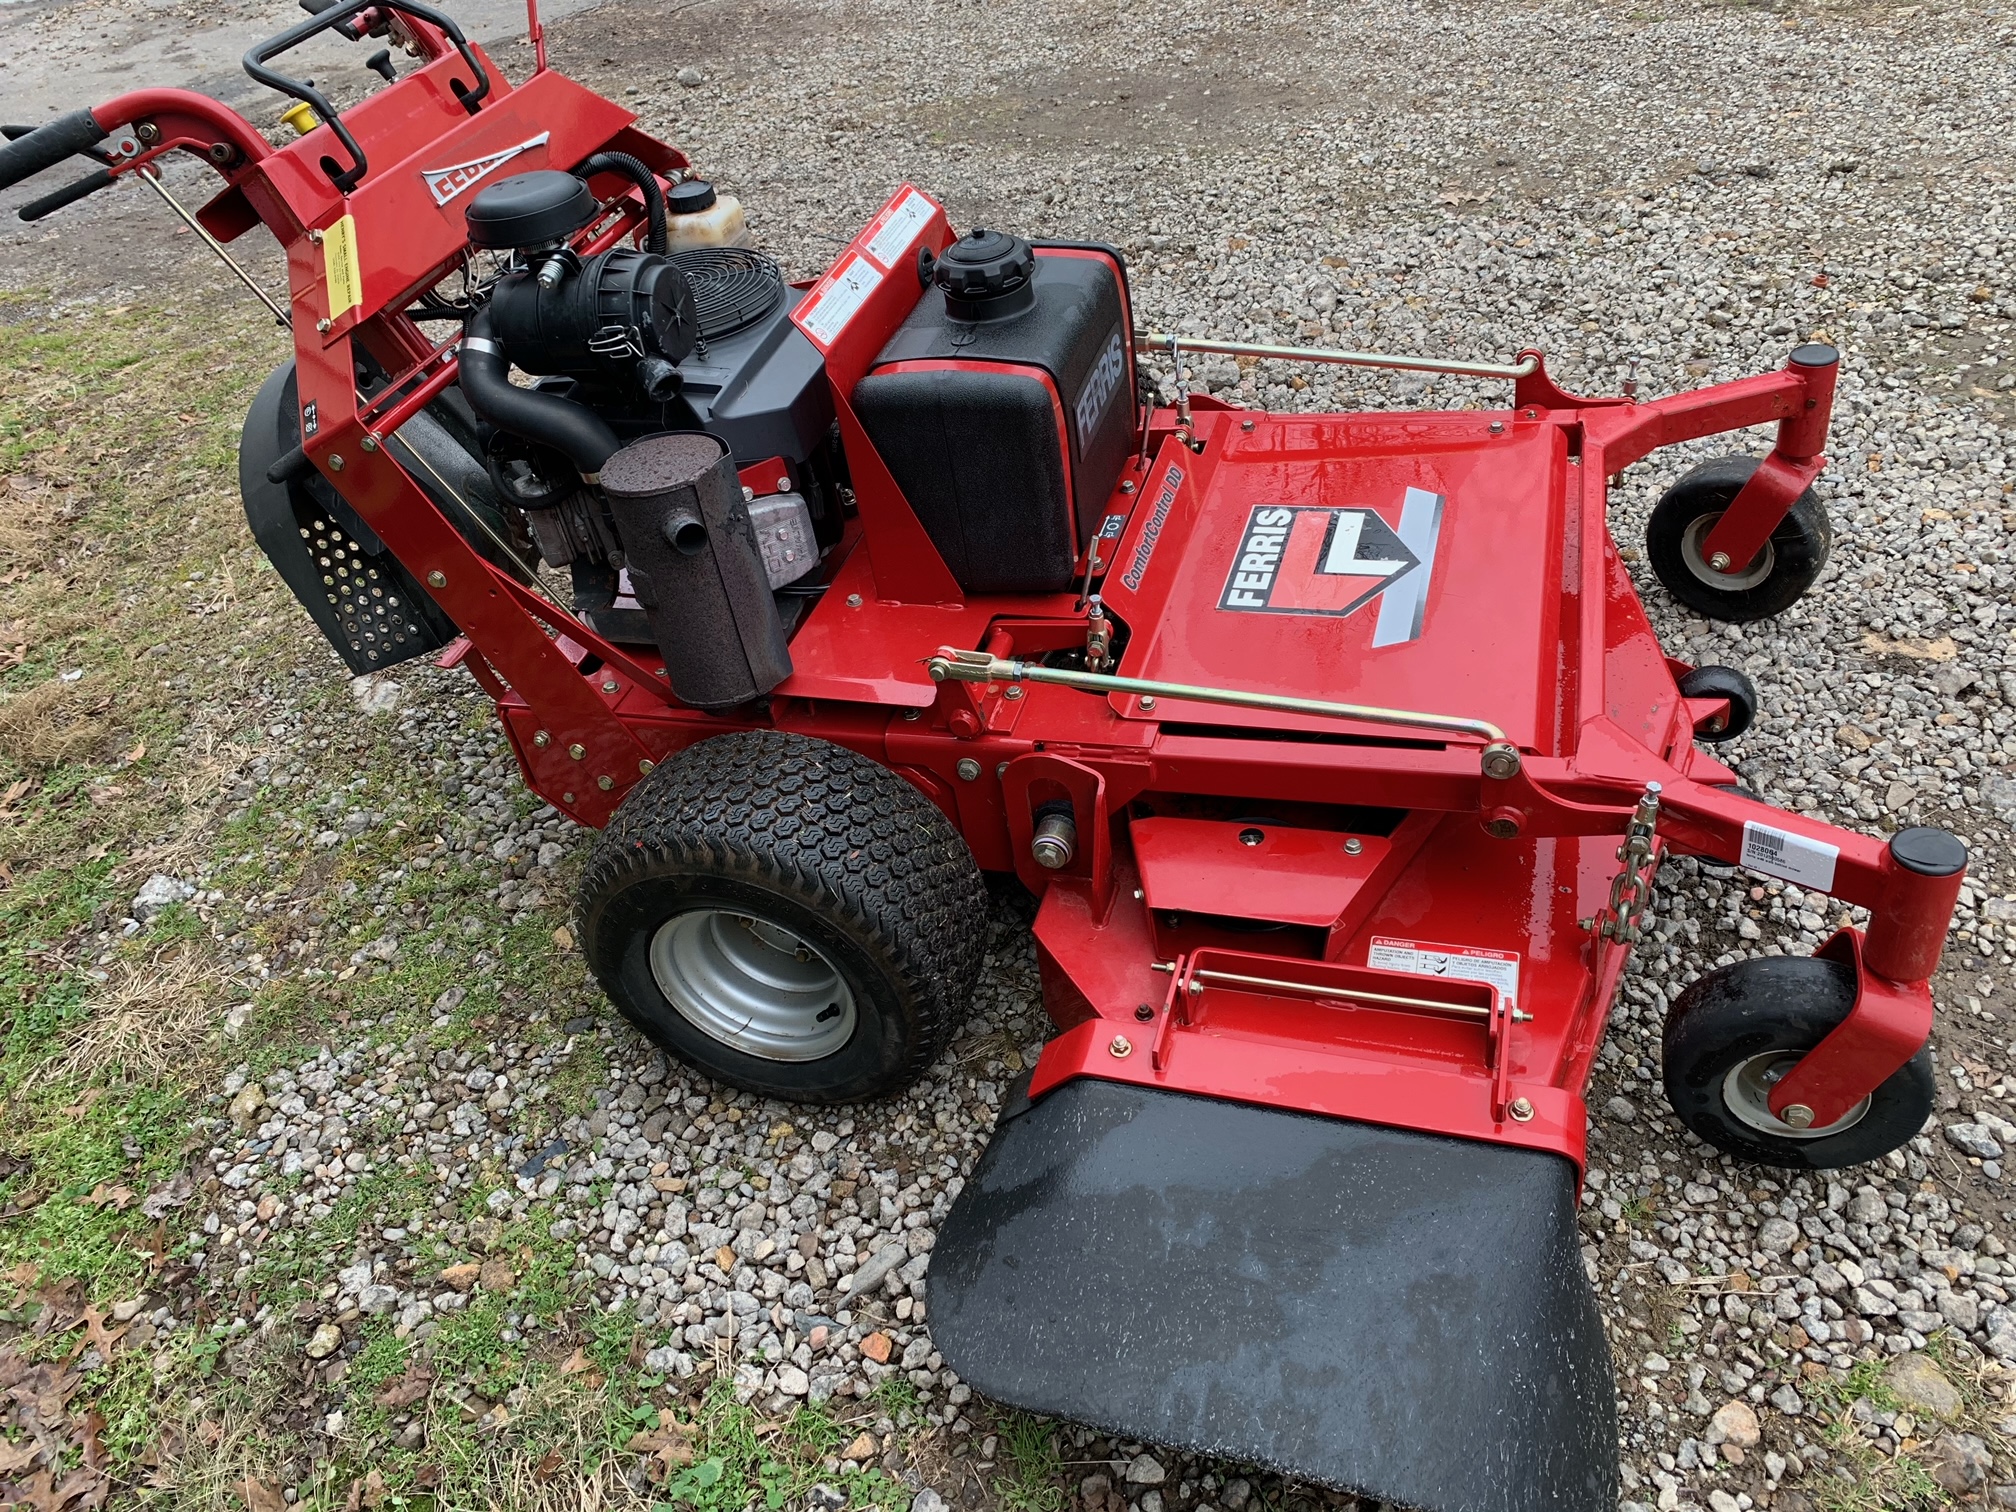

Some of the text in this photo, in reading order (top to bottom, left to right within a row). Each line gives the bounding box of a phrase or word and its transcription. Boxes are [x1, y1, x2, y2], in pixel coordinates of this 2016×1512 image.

[1077, 333, 1123, 449] FERRIS
[1123, 466, 1182, 591] ComfortControl DD
[1226, 508, 1292, 607] FERRIS
[1383, 939, 1415, 949] DANGER
[1470, 949, 1505, 959] PELIGRO
